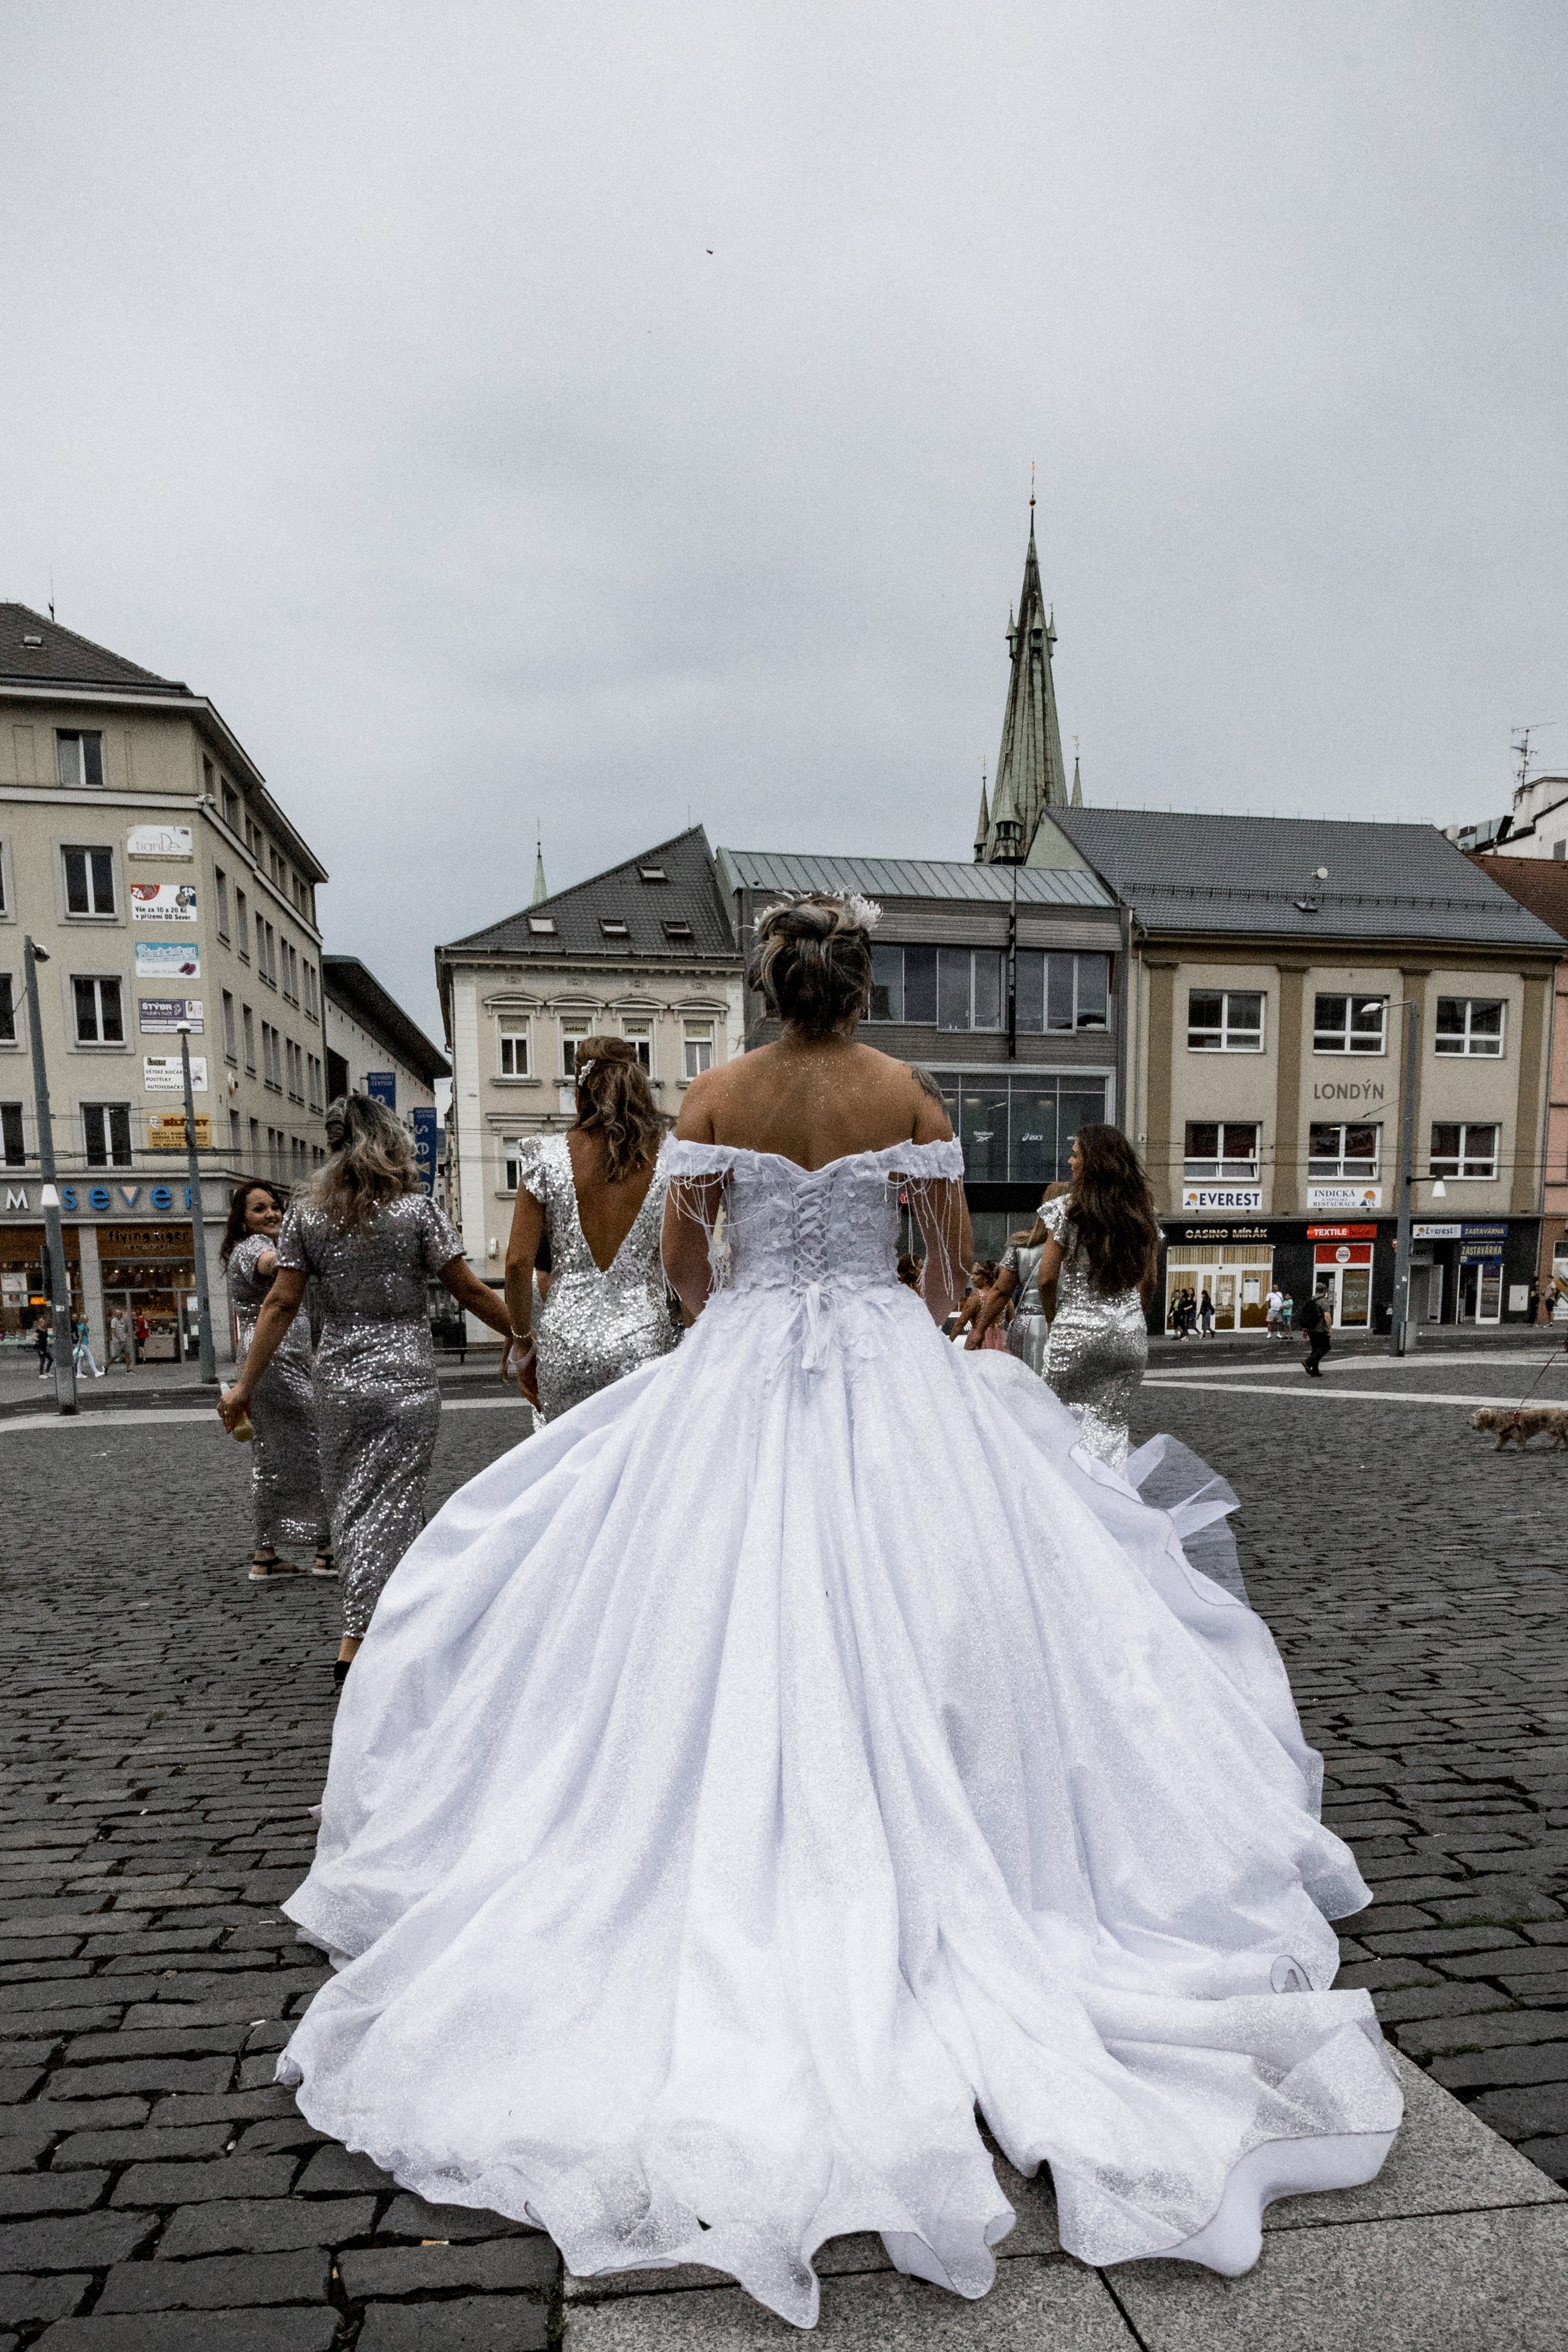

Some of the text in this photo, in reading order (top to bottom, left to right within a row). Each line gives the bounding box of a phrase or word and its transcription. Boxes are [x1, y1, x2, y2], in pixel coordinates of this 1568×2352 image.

[141, 1002, 172, 1011] ŠTÝBR
[1314, 1079, 1384, 1099] LONDÝN
[1314, 1188, 1355, 1197] INDICKÁ
[1199, 1193, 1260, 1206] EVEREST
[108, 1230, 150, 1243] flying
[1185, 1229, 1229, 1238] CASINO
[1461, 1243, 1502, 1255] ZASTAVÁRNA
